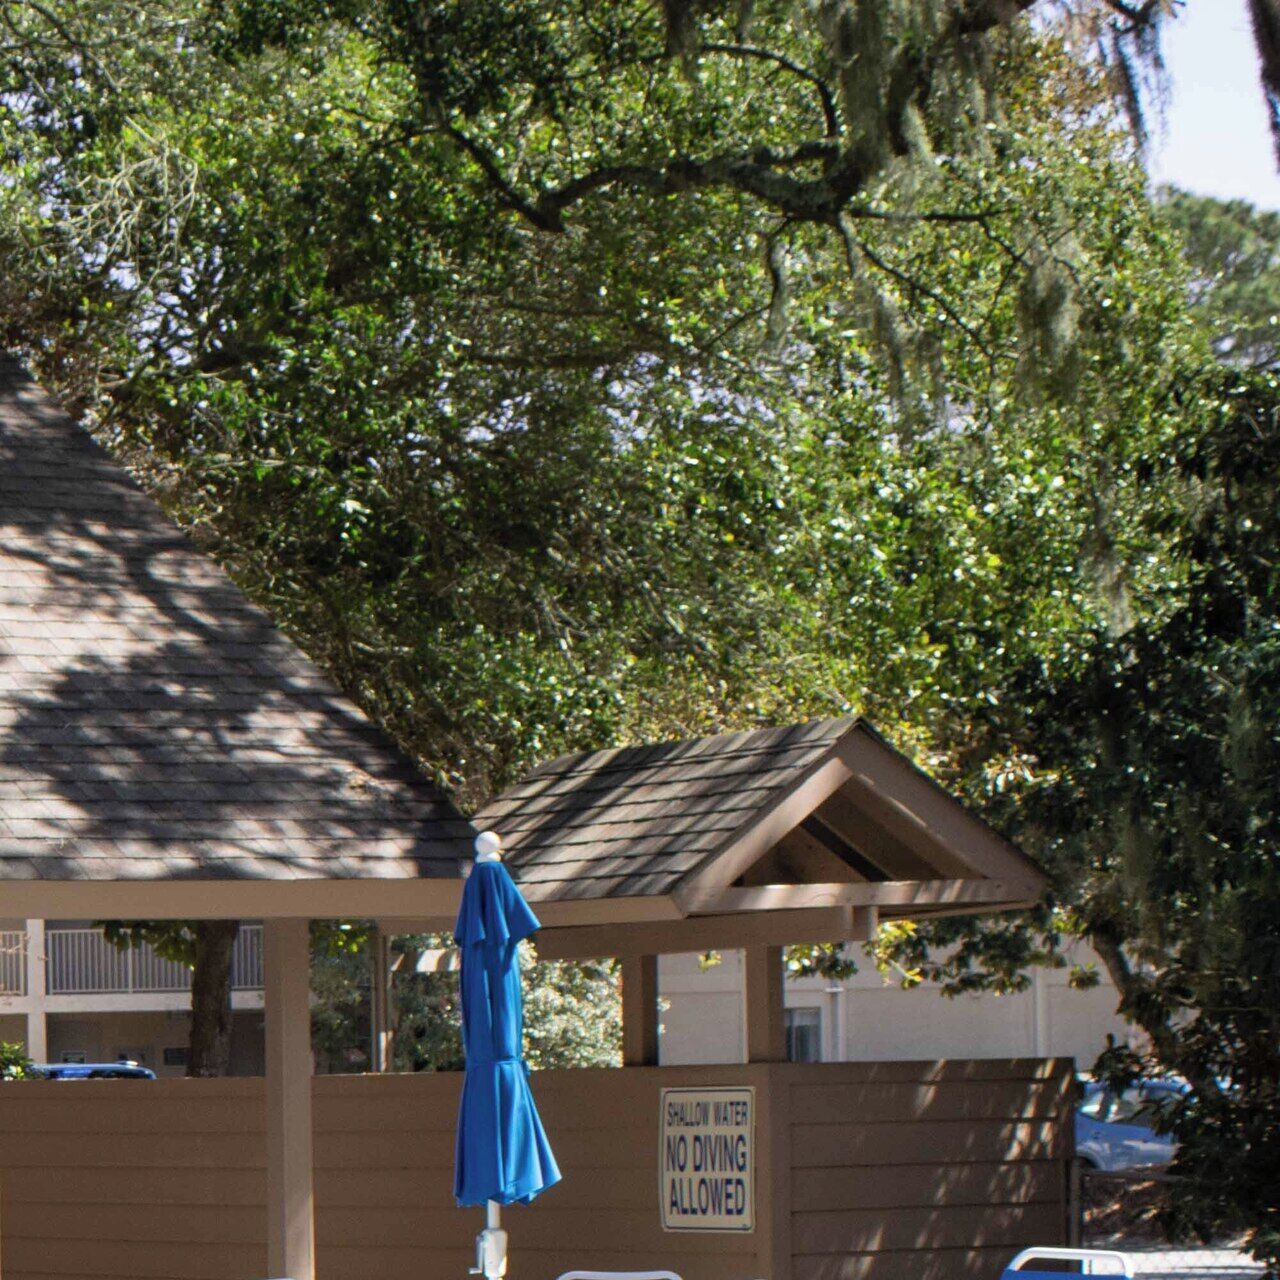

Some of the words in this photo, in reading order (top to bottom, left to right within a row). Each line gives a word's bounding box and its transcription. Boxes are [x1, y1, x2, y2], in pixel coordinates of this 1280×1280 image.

[667, 1101, 709, 1127] SHALLOW
[713, 1101, 748, 1126] WATER
[666, 1134, 688, 1172] NO
[693, 1134, 747, 1172] DIVING
[669, 1178, 746, 1216] ALLOWED
